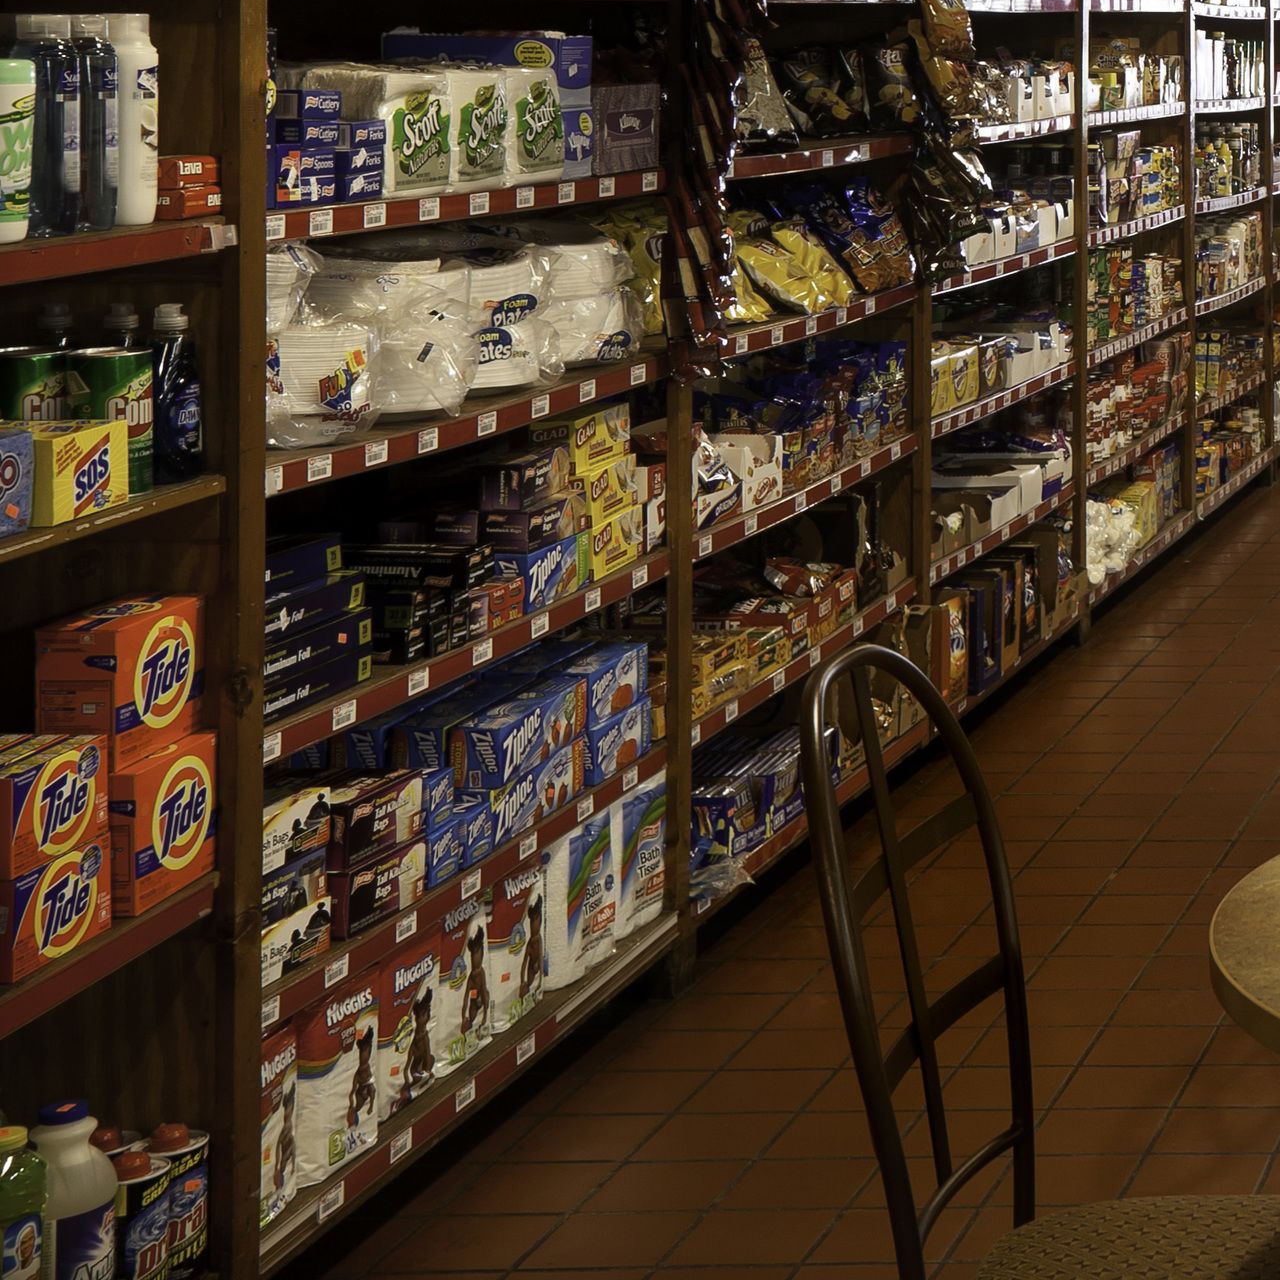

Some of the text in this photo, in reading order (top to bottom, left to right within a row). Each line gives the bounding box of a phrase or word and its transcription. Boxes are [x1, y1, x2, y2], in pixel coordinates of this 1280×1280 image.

[318, 99, 340, 112] Cutlery
[317, 129, 339, 141] Cutlery
[368, 128, 385, 141] Forks
[403, 99, 442, 156] Scott
[179, 160, 203, 176] Lava
[313, 158, 335, 171] Spoons
[365, 154, 382, 166] Forks
[363, 181, 380, 193] Forks
[503, 297, 529, 310] Foam
[493, 308, 530, 328] Plate
[479, 343, 513, 360] ates
[532, 428, 568, 443] GLAD
[576, 416, 596, 447] GLAD
[592, 469, 609, 501] GLAD
[594, 522, 612, 556] GLAD
[529, 544, 562, 604] Ziploc
[297, 646, 312, 662] Foil
[140, 636, 192, 721] Tide
[297, 683, 311, 699] Foil
[470, 731, 498, 774] Ziploc
[503, 708, 542, 783] Ziploc
[38, 768, 89, 852] Tide
[494, 773, 534, 846] Ziploc
[158, 776, 208, 864] Tide
[272, 832, 289, 848] Bags
[639, 846, 661, 865] Bath
[638, 860, 661, 878] Tissue
[504, 869, 540, 900] HUGGIES
[585, 882, 602, 901] Bath
[38, 870, 91, 955] Tide
[443, 897, 480, 932] HUGGIES
[584, 897, 603, 916] Tissue
[270, 942, 288, 960] Bags
[394, 954, 434, 994] HUGGIES
[325, 988, 374, 1027] HUGGIES
[261, 1043, 297, 1088] HUGGIES
